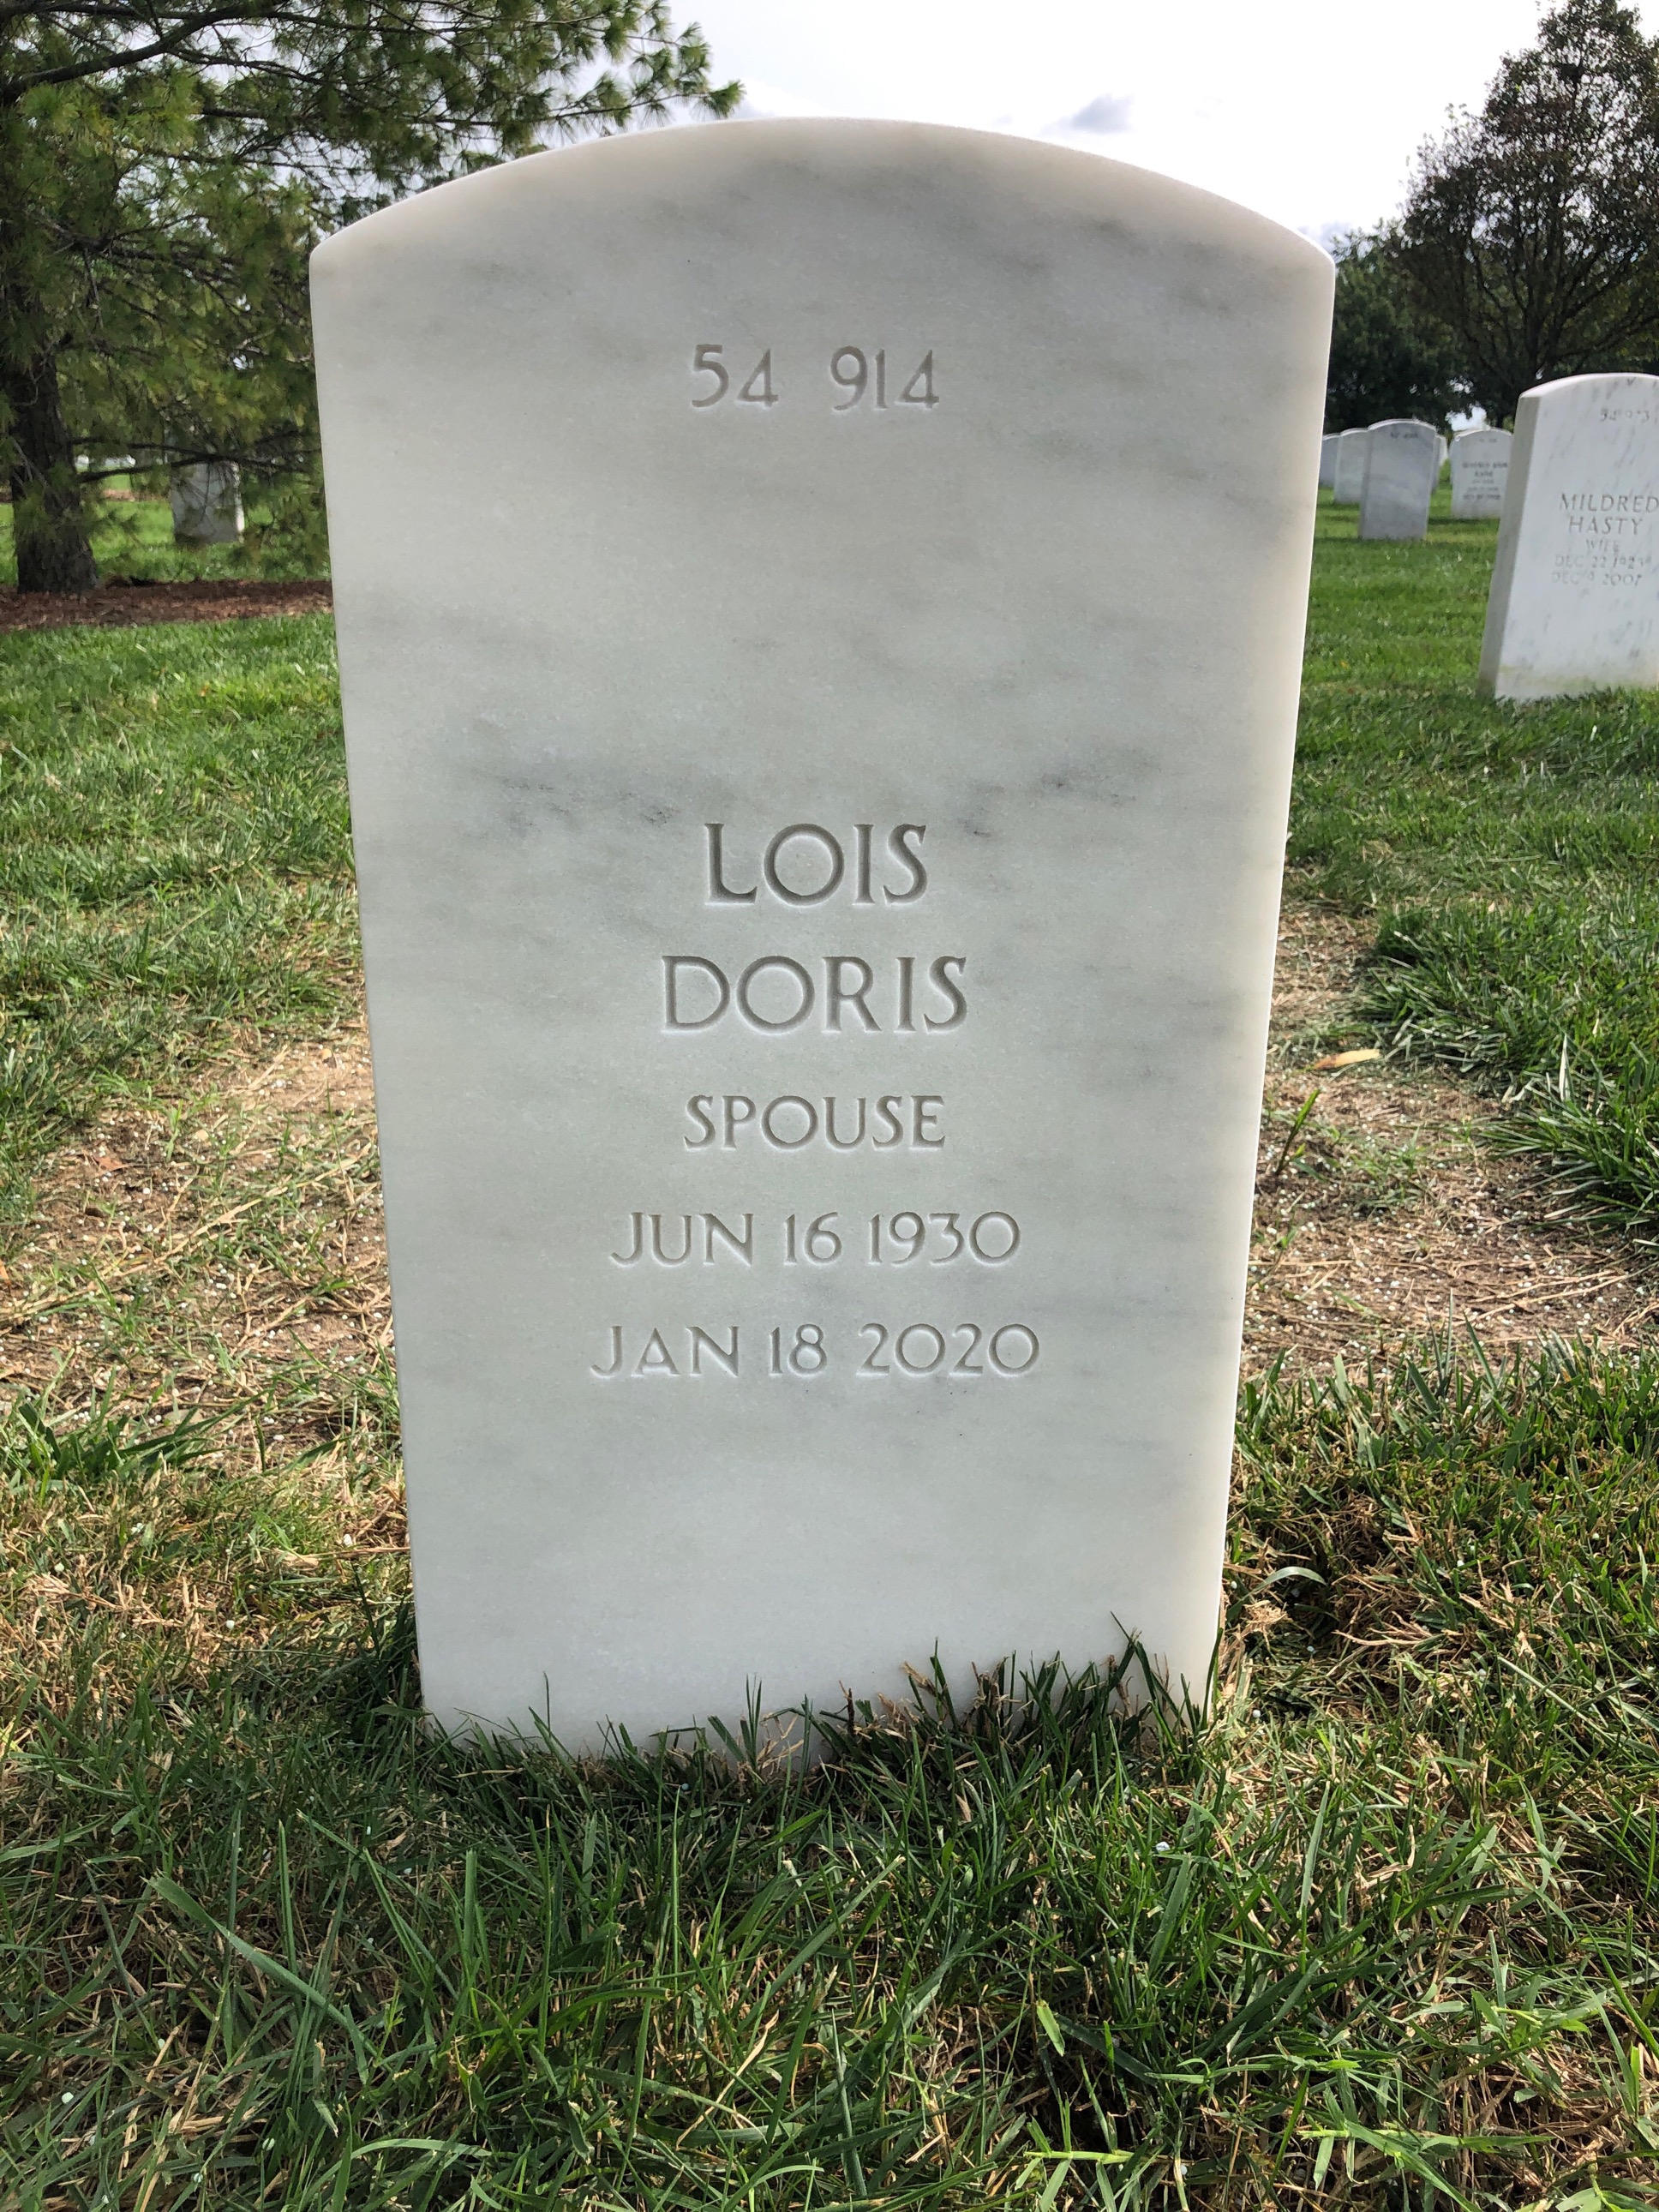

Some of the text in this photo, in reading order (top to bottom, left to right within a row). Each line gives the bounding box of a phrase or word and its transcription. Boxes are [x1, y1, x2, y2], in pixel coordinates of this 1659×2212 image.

[692, 344, 940, 411] 54 914
[1560, 493, 1659, 513] MILDRED
[1568, 515, 1644, 535] HASTY
[704, 823, 928, 907] LOIS
[661, 955, 967, 1035] DORIS
[683, 1094, 946, 1151] SPOUSE
[610, 1211, 1021, 1266] JUN 16 1930
[590, 1322, 1041, 1379] JAN 18 2020
